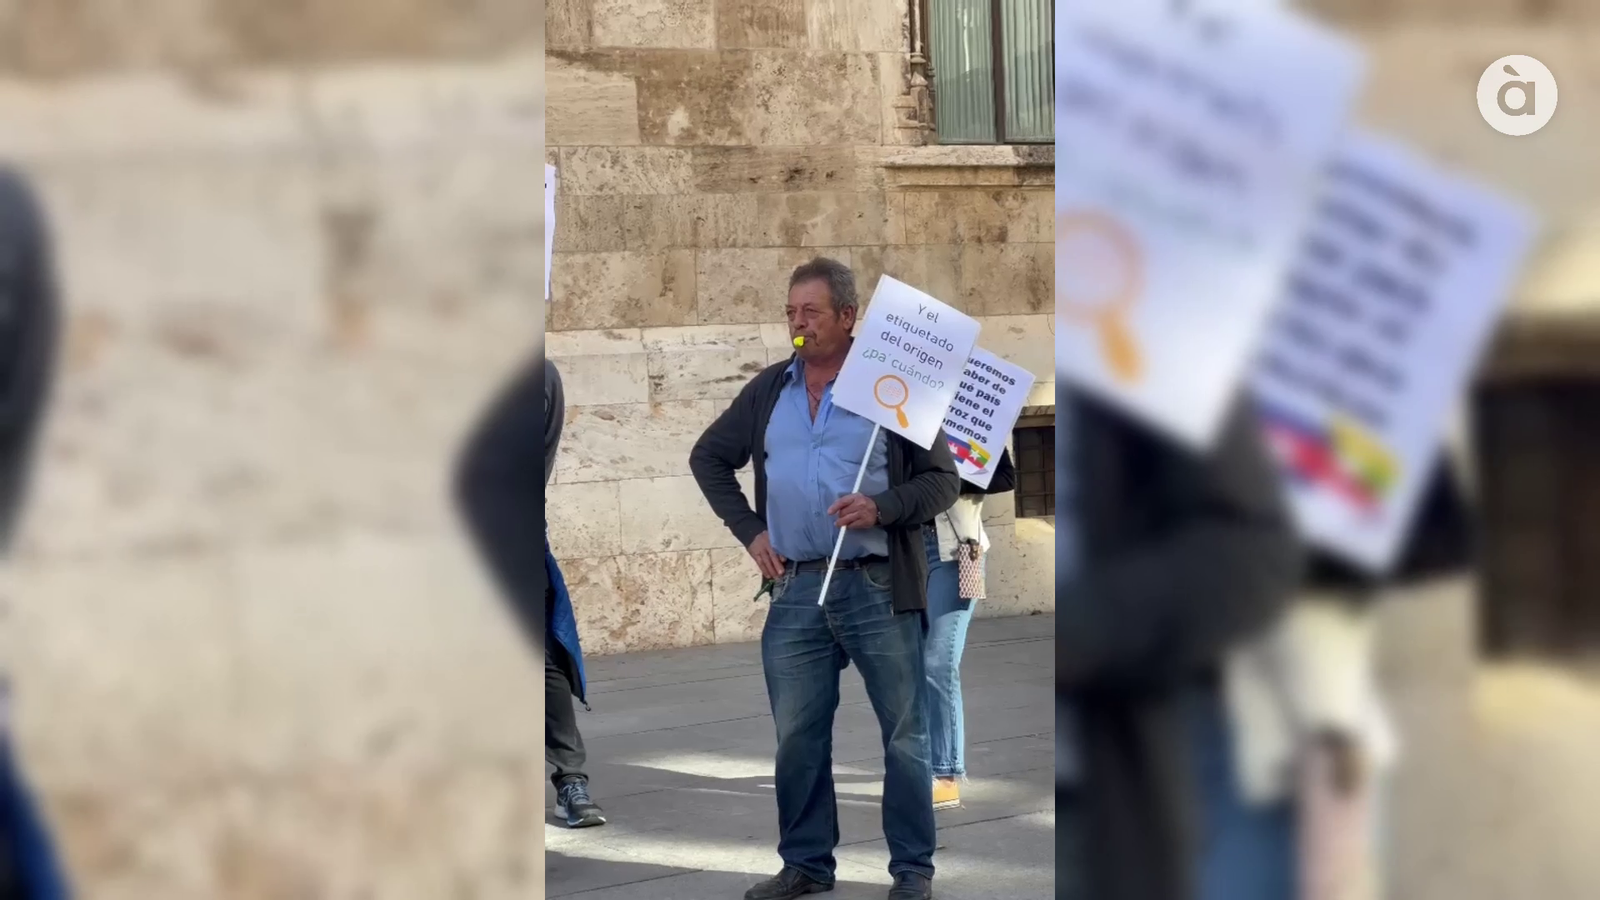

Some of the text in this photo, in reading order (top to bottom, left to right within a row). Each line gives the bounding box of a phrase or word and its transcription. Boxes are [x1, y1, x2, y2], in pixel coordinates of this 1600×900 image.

[918, 303, 940, 324] Y el
[885, 313, 954, 352] etiquetado
[880, 330, 944, 370] del origen
[891, 359, 944, 391] cuándo?
[963, 368, 1006, 395] aber de
[967, 357, 1016, 386] ueremos
[954, 391, 995, 418] iene el
[959, 380, 1001, 407] ué país
[942, 418, 988, 444] memos
[948, 405, 993, 432] roz que
